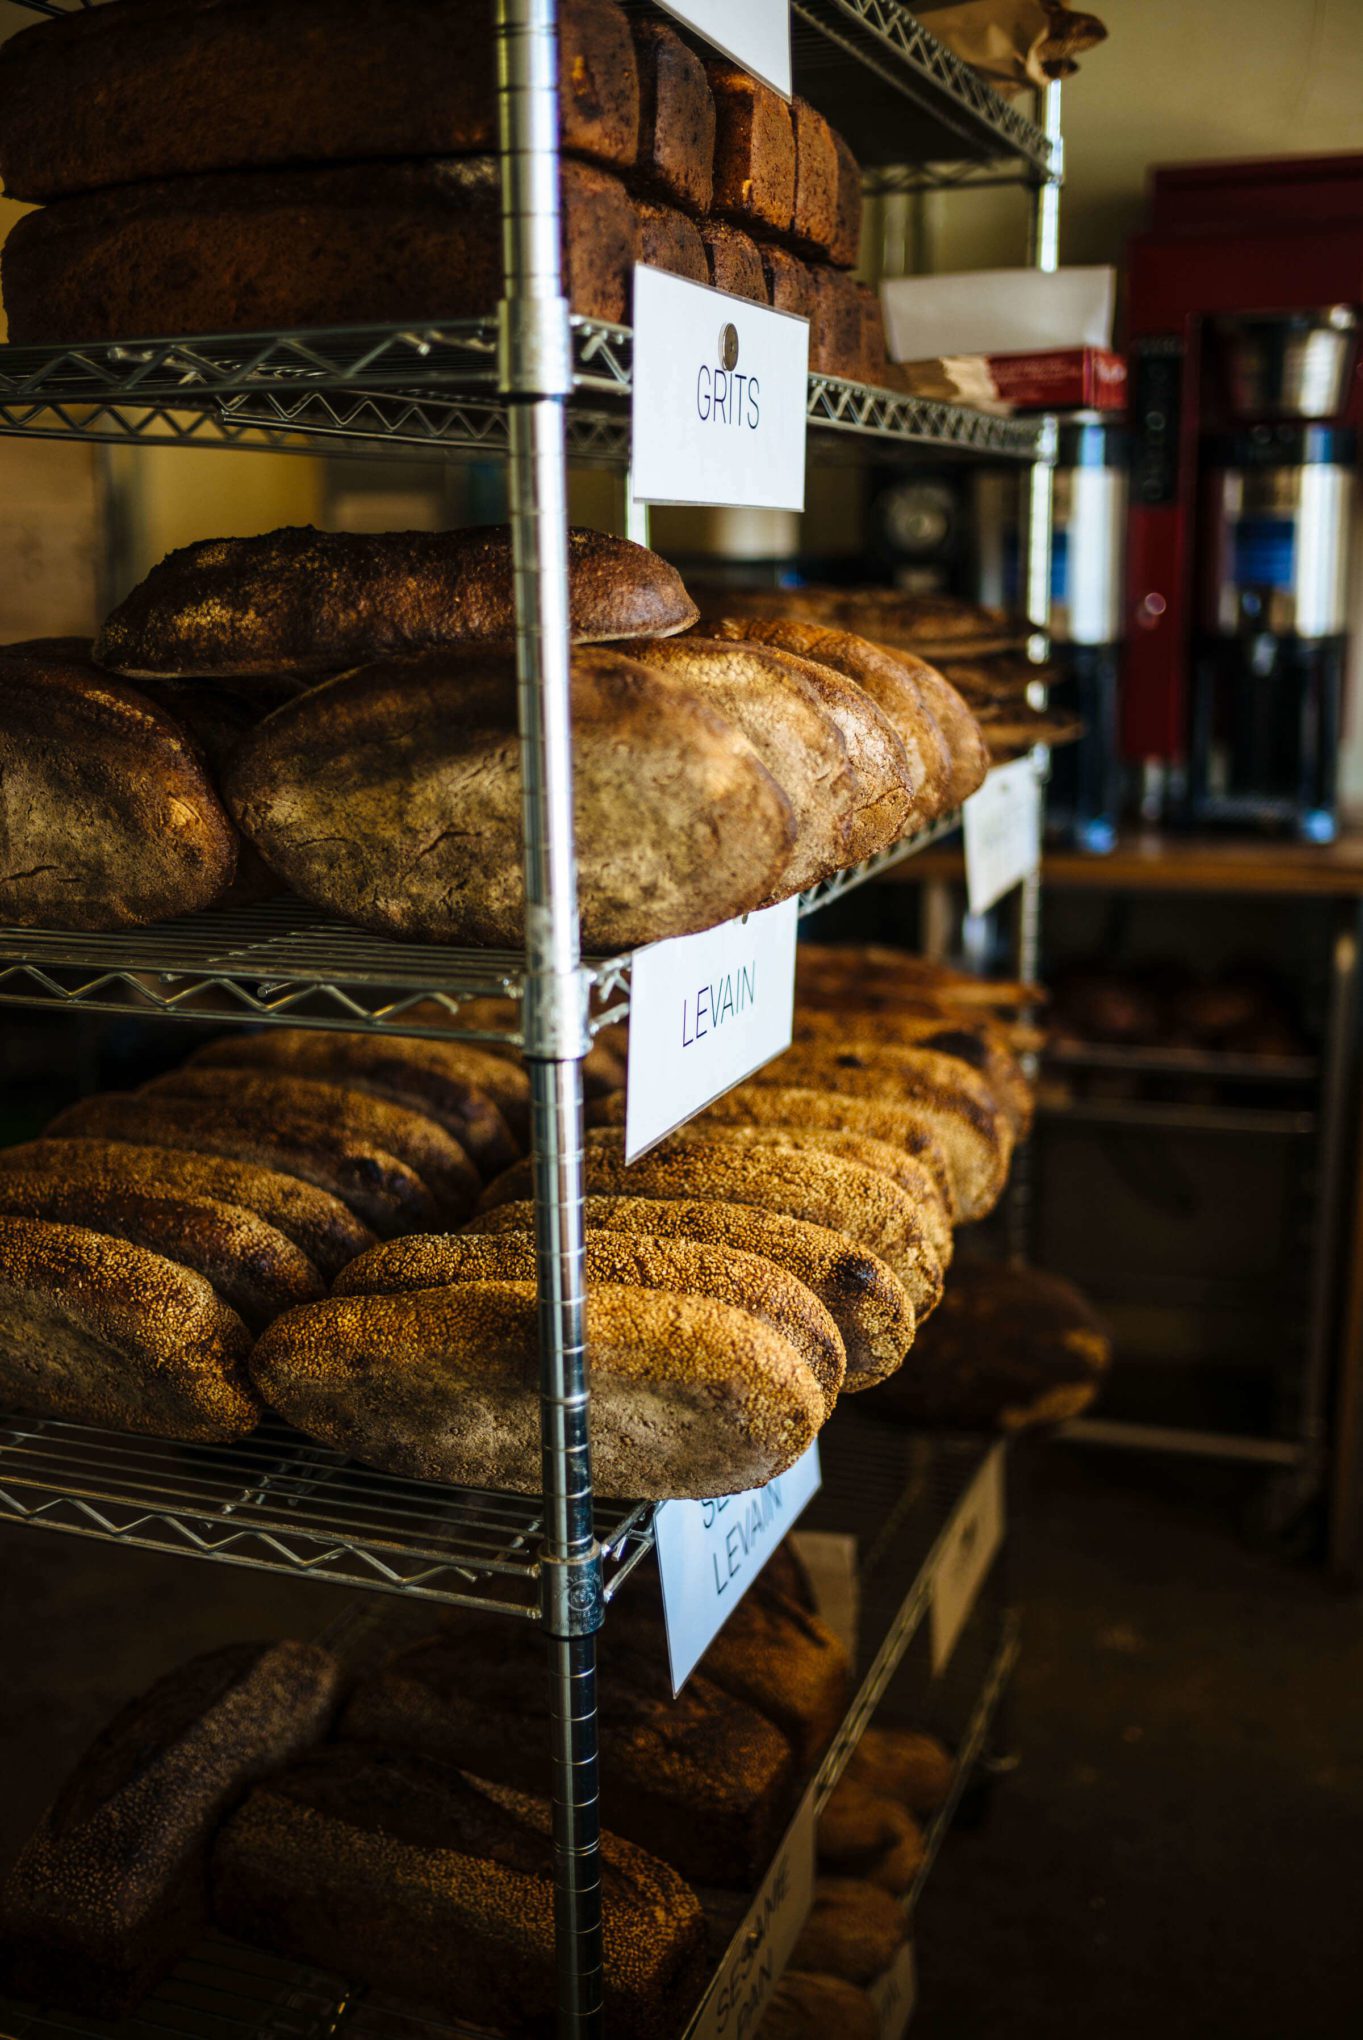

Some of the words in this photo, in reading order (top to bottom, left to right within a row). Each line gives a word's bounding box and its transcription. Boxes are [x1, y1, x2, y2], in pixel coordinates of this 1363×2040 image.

[697, 364, 760, 429] GRITS
[683, 959, 756, 1048] LEVAIN
[713, 1475, 783, 1595] LEVAIN
